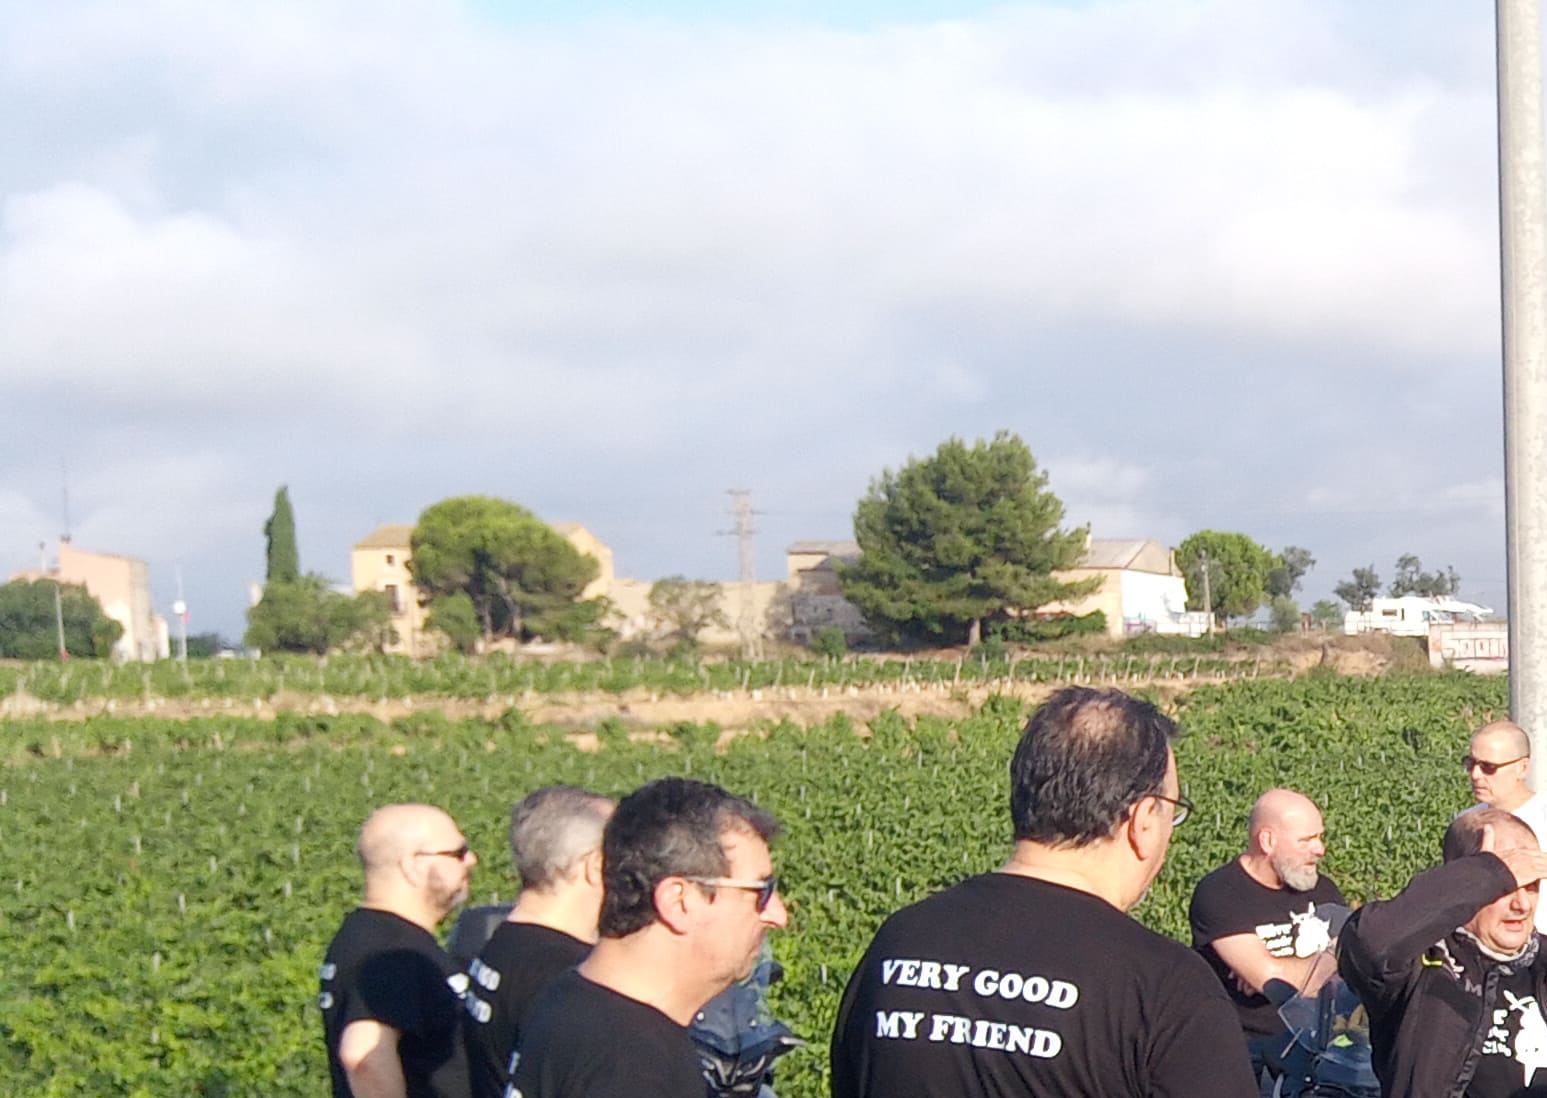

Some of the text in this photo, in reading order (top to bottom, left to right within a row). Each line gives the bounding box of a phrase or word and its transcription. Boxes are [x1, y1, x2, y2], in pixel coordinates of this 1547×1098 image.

[881, 959, 1079, 1009] VERY GOOD
[875, 1010, 1063, 1059] MY FRIEND
